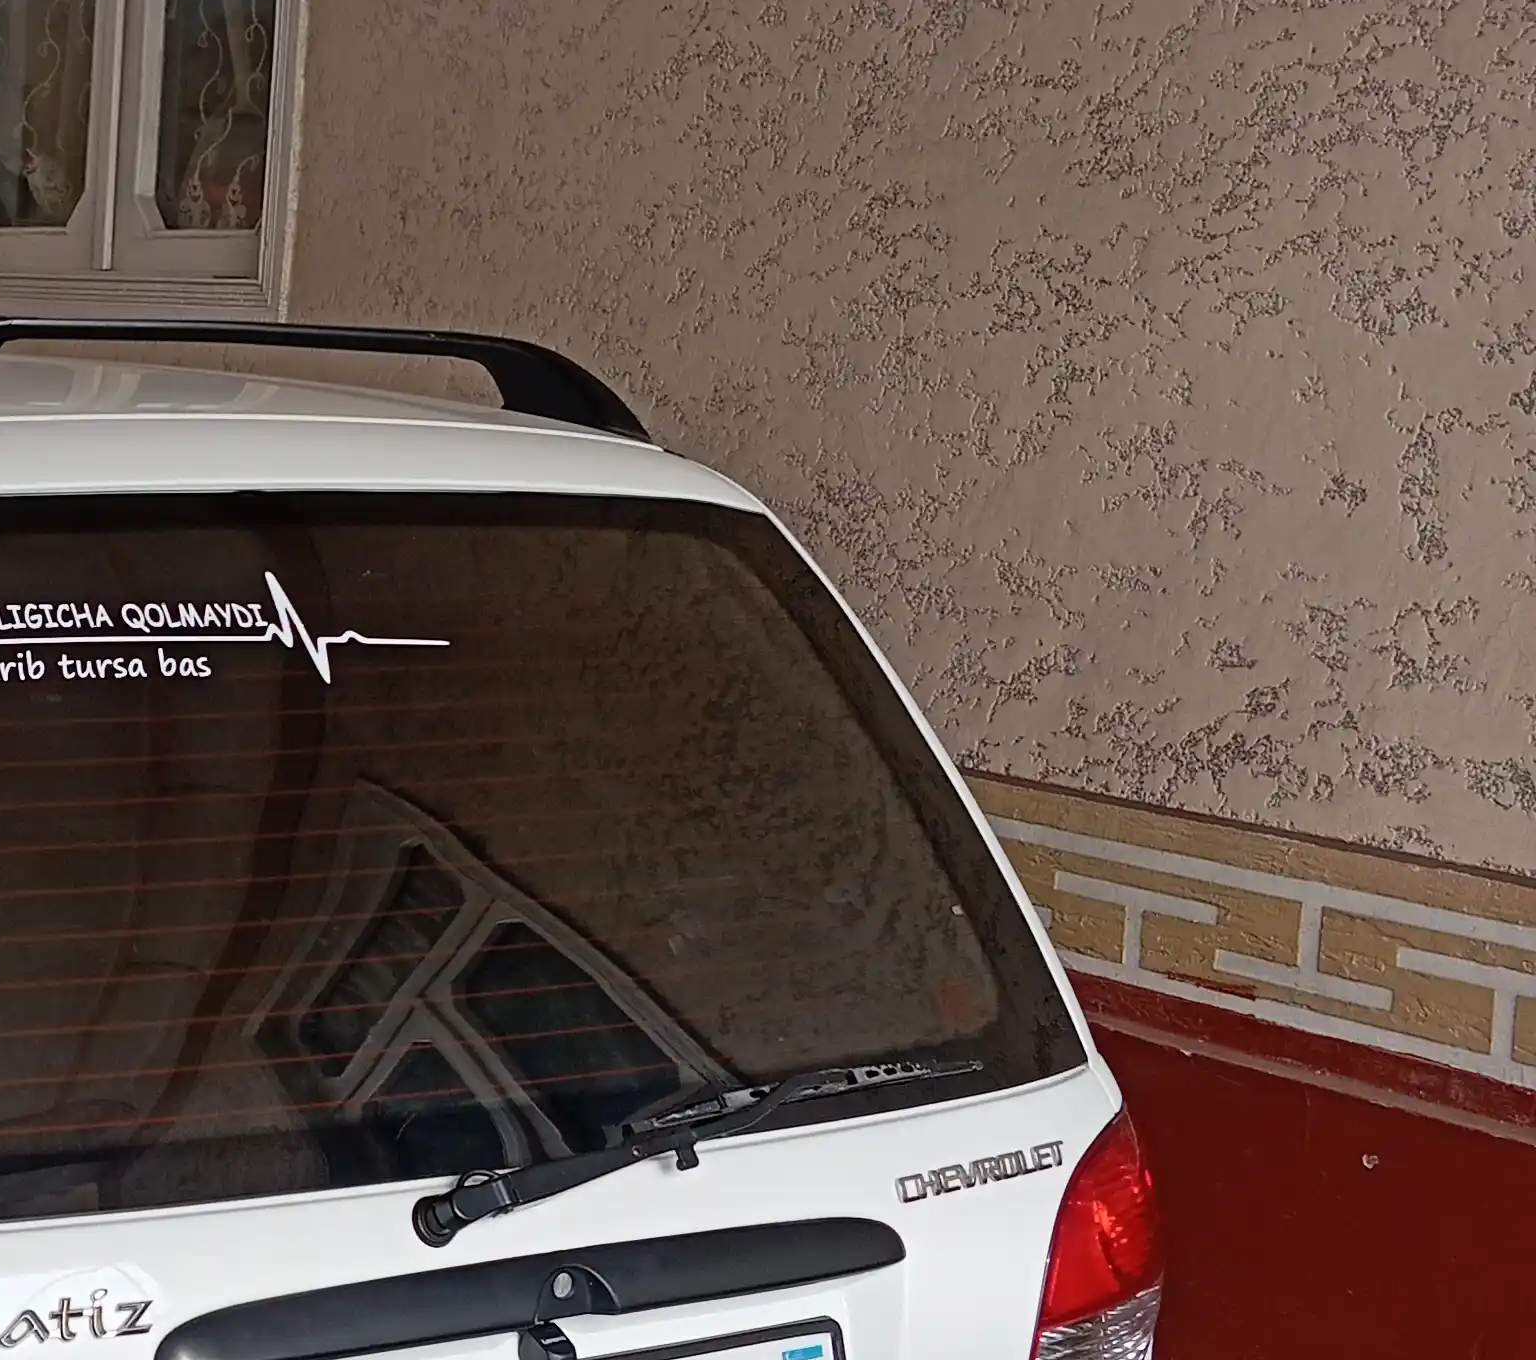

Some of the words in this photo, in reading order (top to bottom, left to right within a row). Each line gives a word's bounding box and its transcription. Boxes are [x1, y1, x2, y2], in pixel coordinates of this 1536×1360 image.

[121, 602, 268, 633] QOLMAYDI
[58, 654, 148, 680] tursa
[158, 648, 212, 677] bas
[895, 1140, 1063, 1203] CHEVROLET
